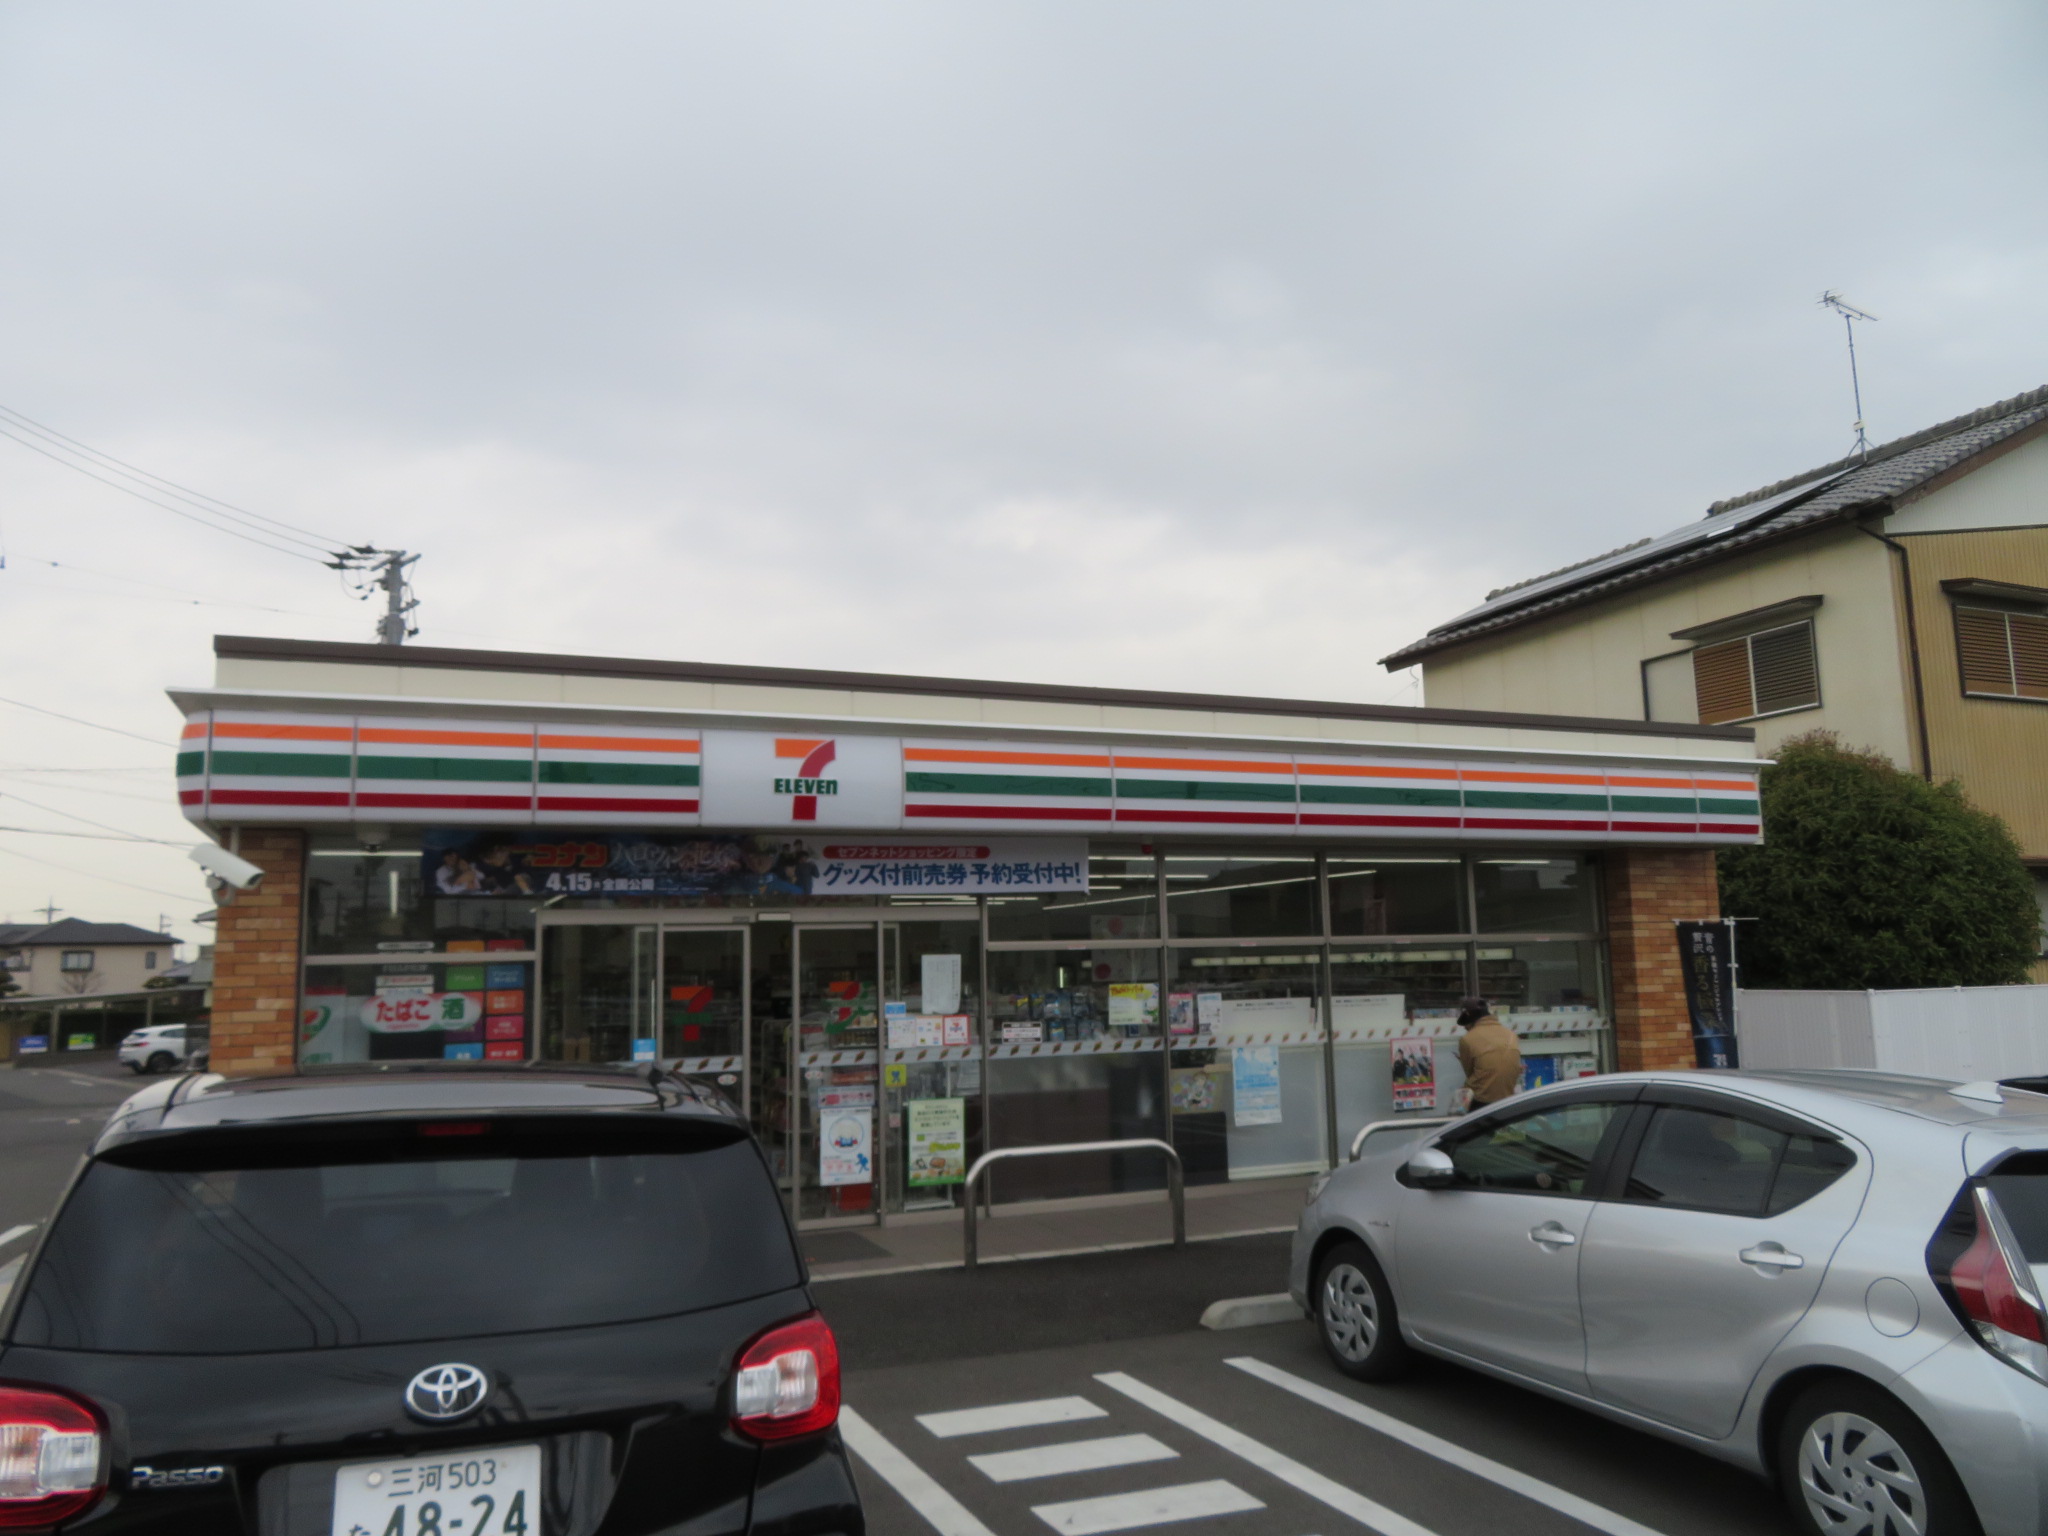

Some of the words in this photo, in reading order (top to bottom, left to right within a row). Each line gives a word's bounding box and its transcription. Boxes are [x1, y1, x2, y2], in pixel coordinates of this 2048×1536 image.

[546, 872, 592, 892] 4.15
[376, 1000, 431, 1022] たばこ
[441, 998, 465, 1020] 酒
[131, 1465, 224, 1489] Passo
